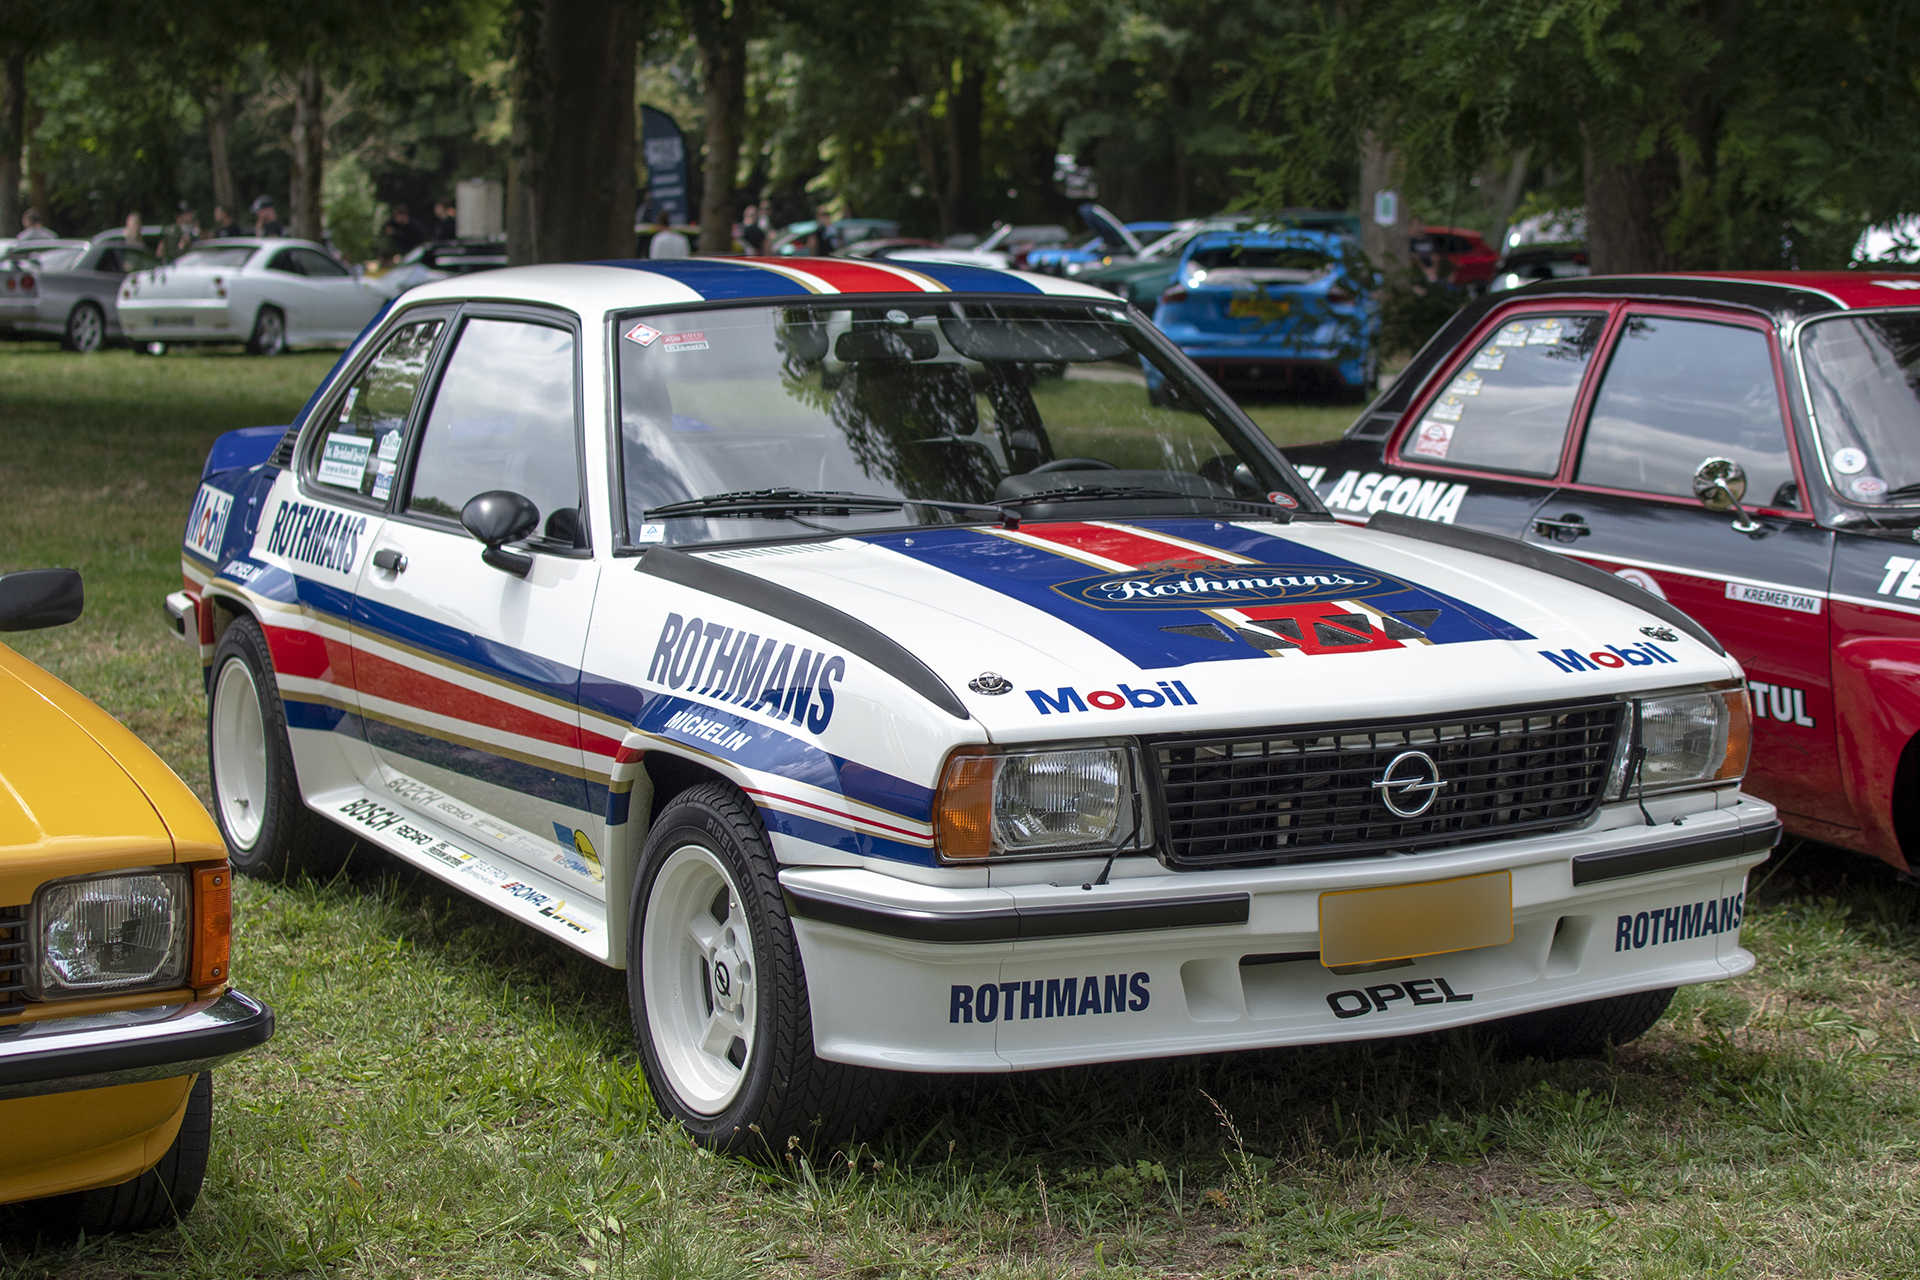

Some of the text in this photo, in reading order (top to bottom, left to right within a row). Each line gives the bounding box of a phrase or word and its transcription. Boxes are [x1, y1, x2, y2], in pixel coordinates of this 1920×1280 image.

[1324, 470, 1469, 524] ASCONA
[187, 488, 231, 556] Mobil
[267, 500, 367, 574] ROTHMANS
[222, 560, 263, 583] MICHELIN
[1100, 573, 1368, 600] Rothmans
[1877, 555, 1920, 600] TE
[1743, 588, 1815, 610] KREMER YAN
[647, 612, 845, 735] ROTHMANS
[1537, 642, 1678, 673] Mobil
[1025, 680, 1198, 715] Mobil
[1749, 680, 1816, 728] TUL
[664, 711, 752, 751] MICHELIN
[339, 798, 405, 831] BOSCH
[392, 825, 433, 845] RECARO
[506, 883, 552, 907] RONAL
[706, 818, 742, 871] PIRELLI
[741, 874, 772, 996] CINTURATO
[1615, 892, 1743, 952] ROTHMANS
[950, 972, 1150, 1023] ROTHMANS
[1326, 978, 1473, 1018] OPEL
